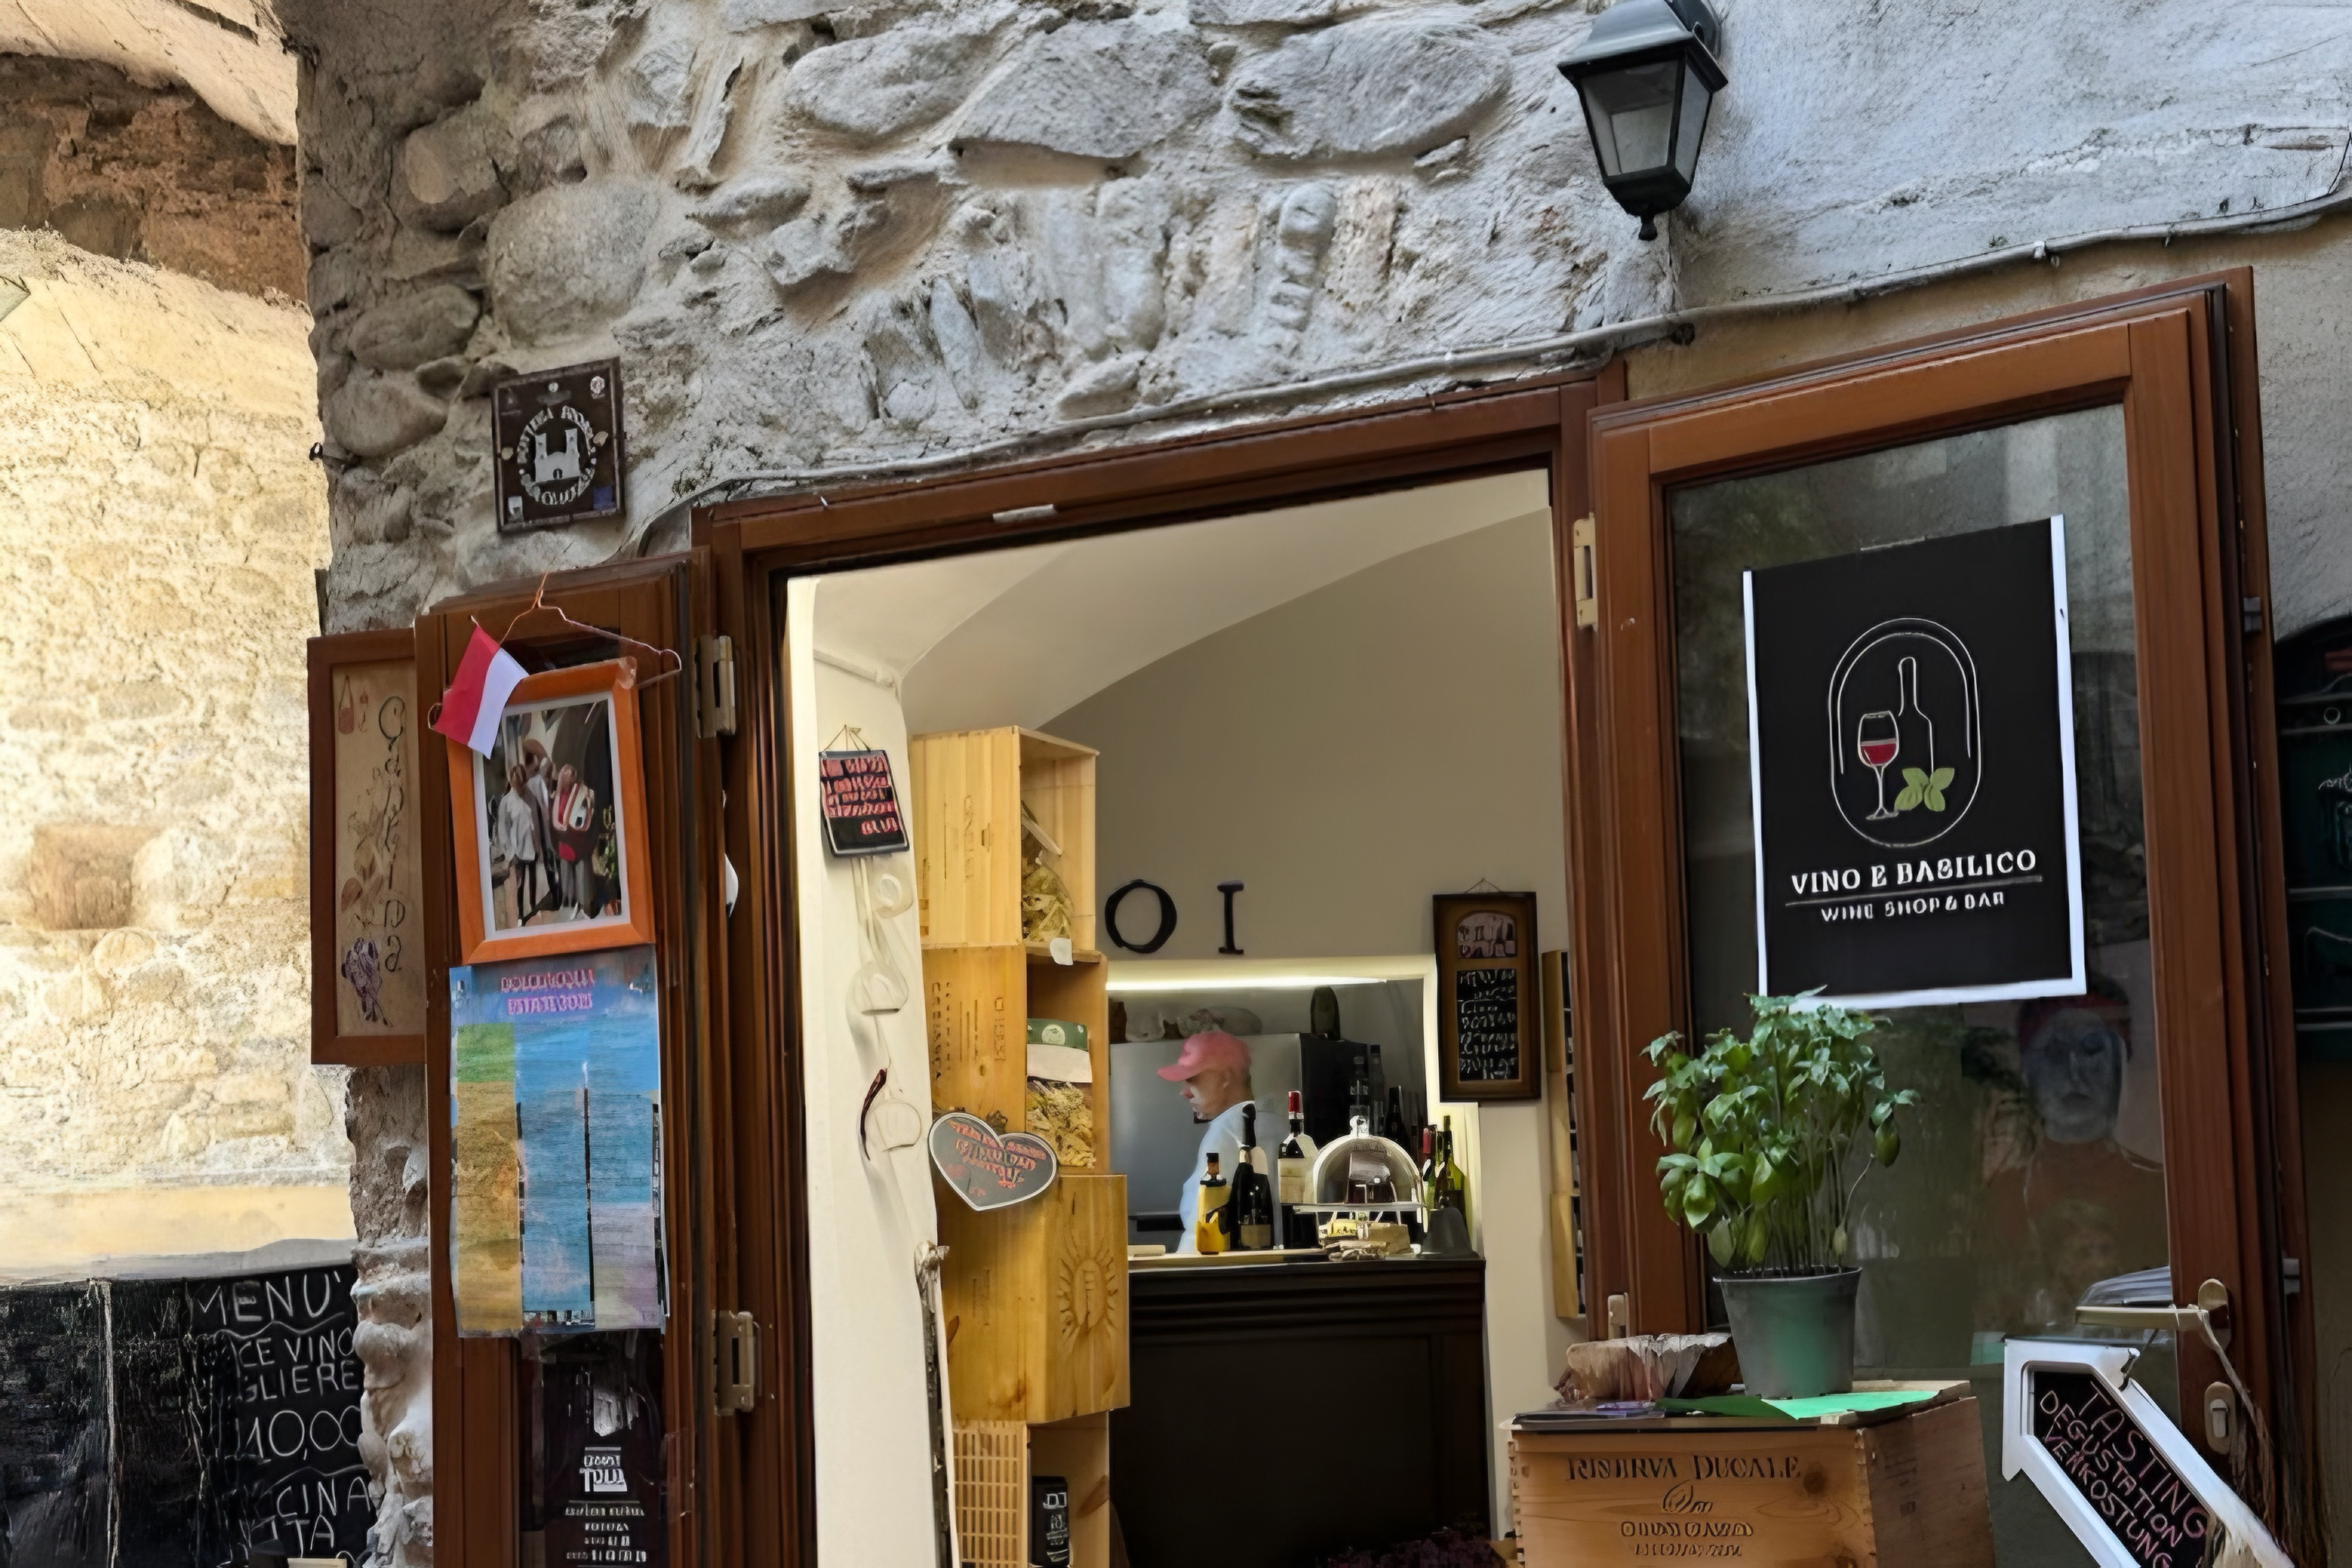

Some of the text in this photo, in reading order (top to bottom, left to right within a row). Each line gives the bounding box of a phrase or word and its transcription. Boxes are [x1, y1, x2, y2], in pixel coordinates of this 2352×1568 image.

[1791, 869, 1861, 895] VINO
[1897, 849, 2036, 885] BASILICO
[284, 1327, 356, 1362] VINO
[2078, 1380, 2208, 1538] TASTING
